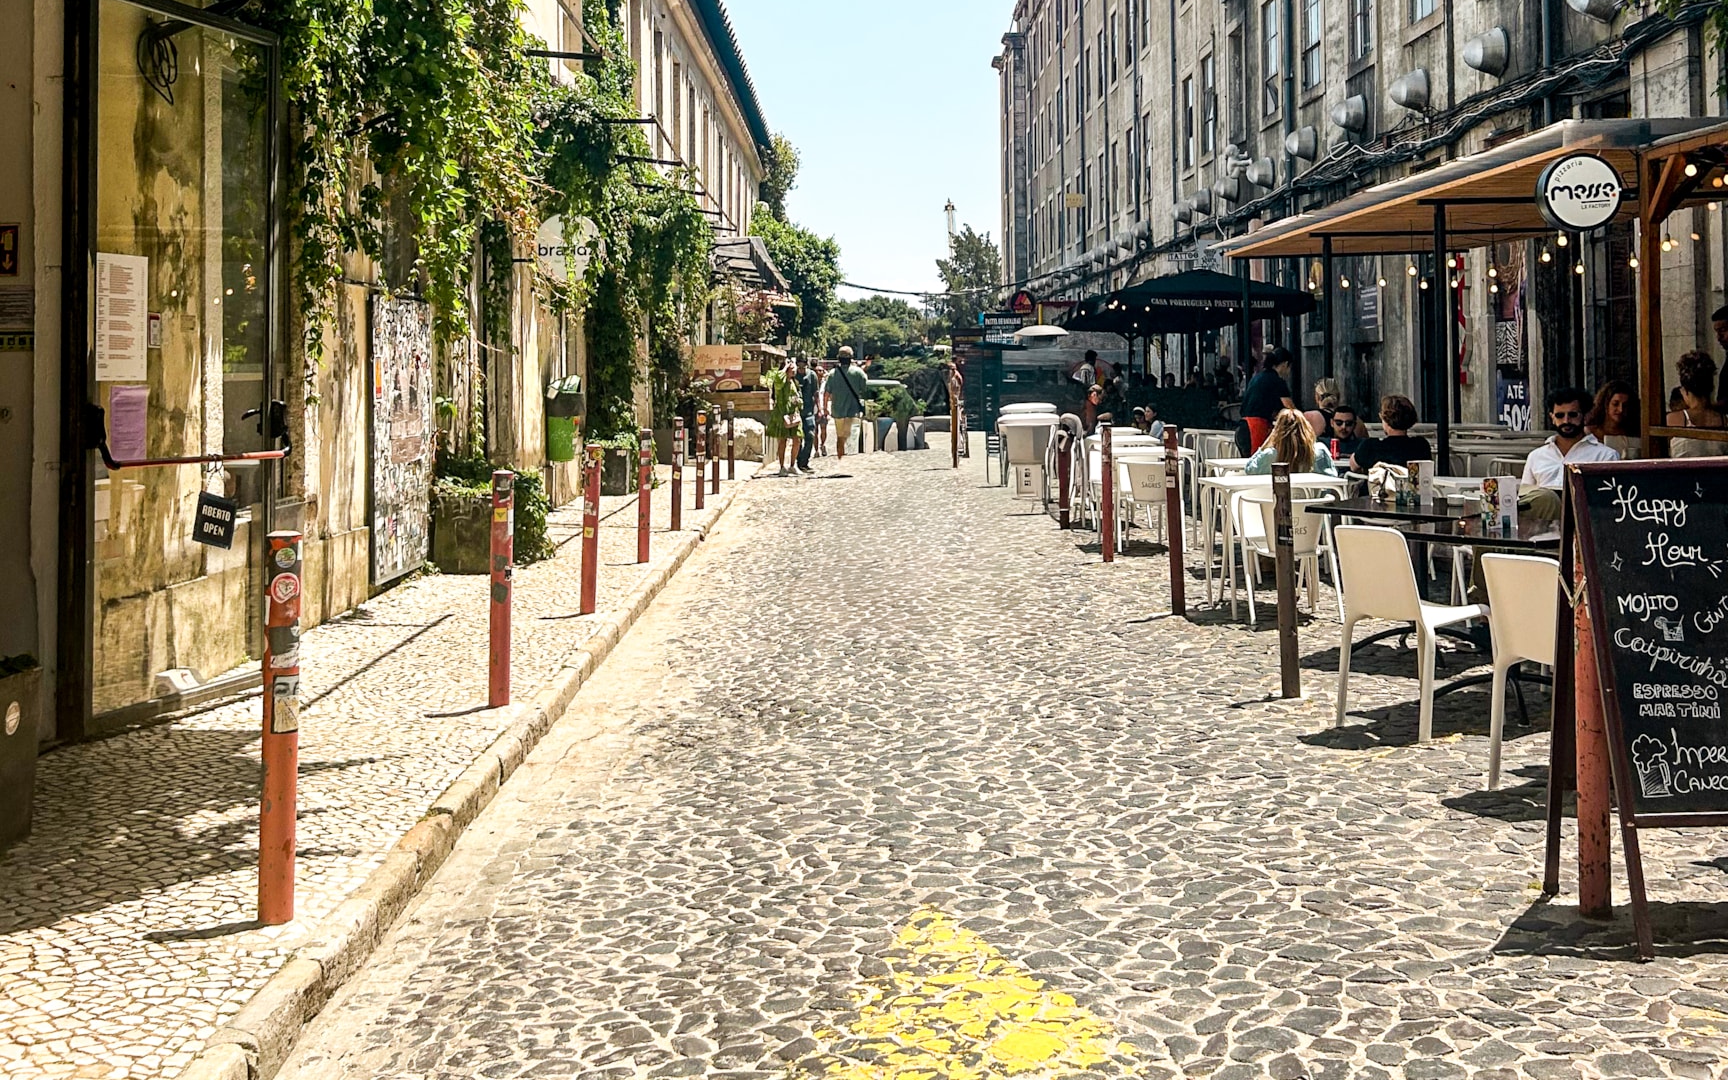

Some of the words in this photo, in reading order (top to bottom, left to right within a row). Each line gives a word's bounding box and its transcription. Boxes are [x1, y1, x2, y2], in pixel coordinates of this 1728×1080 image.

[1554, 160, 1583, 182] pizzaria
[1170, 251, 1199, 260] TATTOO
[1150, 298, 1168, 306] CASA
[1169, 299, 1212, 308] PORTUGUESA
[1214, 299, 1239, 308] PASTEL
[1507, 381, 1524, 399] ATÉ
[1499, 404, 1531, 431] -50%
[1141, 481, 1162, 489] SAGRES
[202, 504, 231, 522] ABERTO
[1612, 485, 1689, 527] Happy
[203, 521, 225, 537] OPEN
[1642, 531, 1708, 568] Hour
[1633, 683, 1719, 700] ESPRESSO
